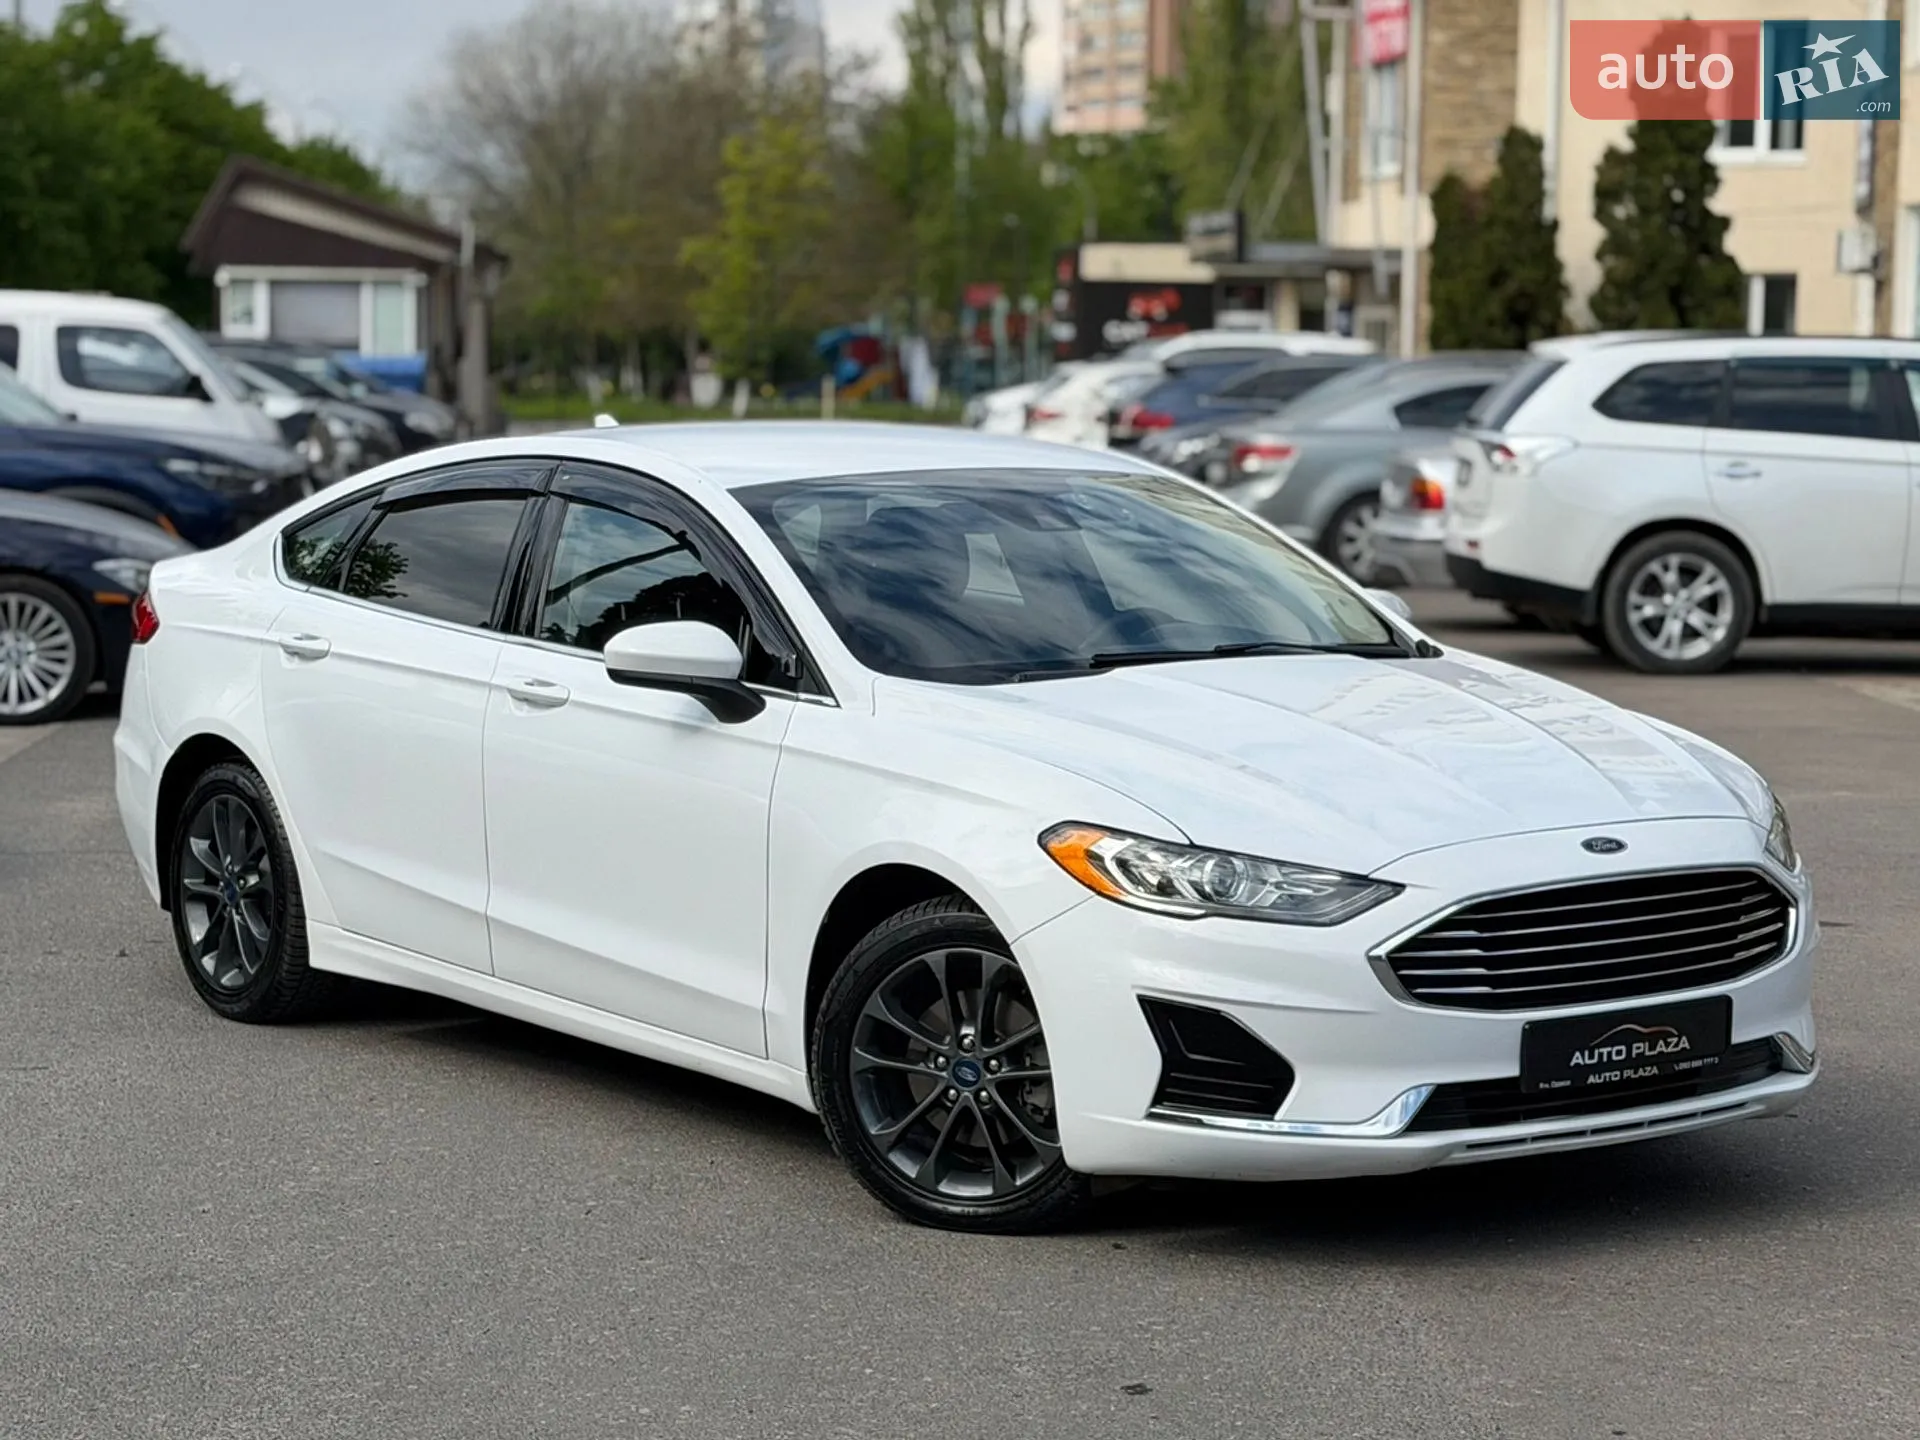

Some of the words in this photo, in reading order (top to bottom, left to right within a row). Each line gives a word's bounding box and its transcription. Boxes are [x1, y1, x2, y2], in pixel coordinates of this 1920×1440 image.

[1570, 1045, 1627, 1067] AUTO
[1632, 1035, 1691, 1058] PLAZA
[1587, 1070, 1621, 1084] AUTO
[1623, 1065, 1659, 1079] PLAZA
